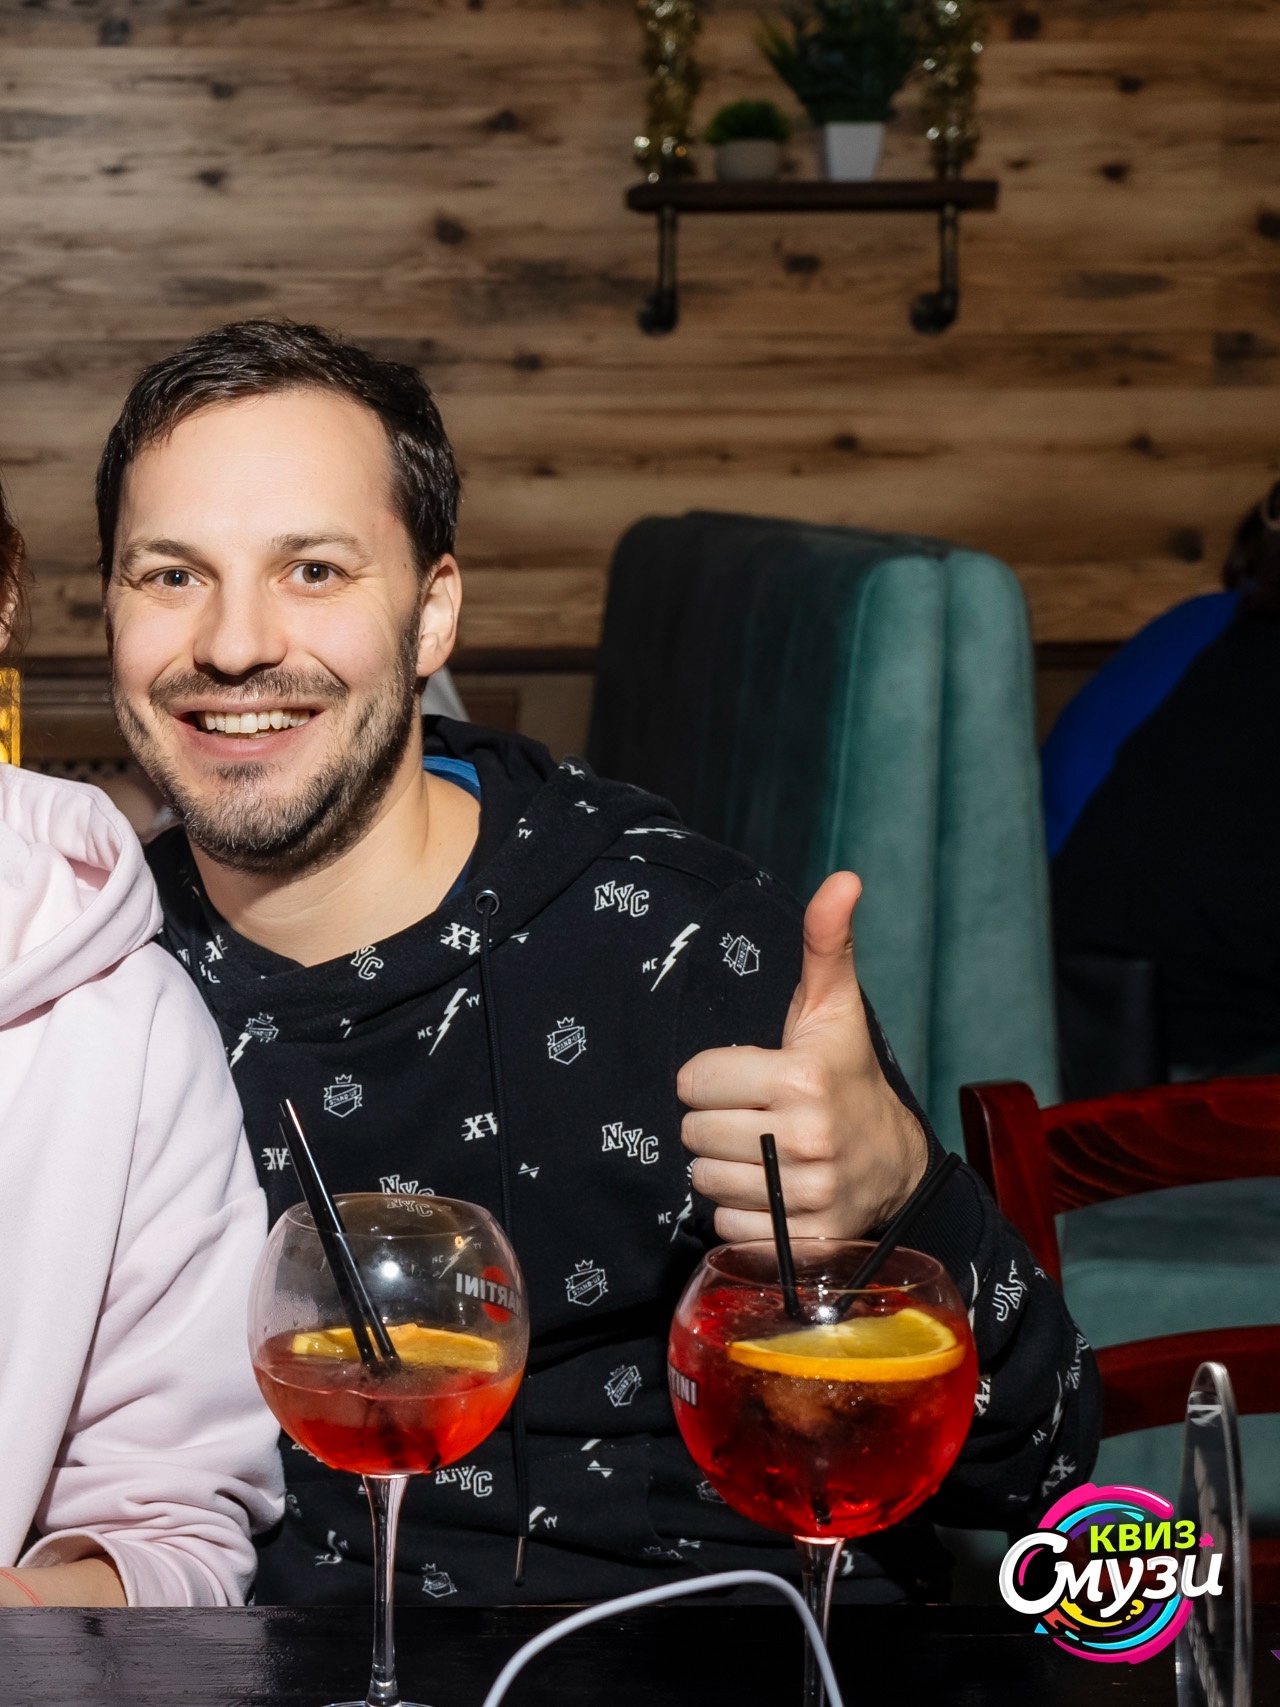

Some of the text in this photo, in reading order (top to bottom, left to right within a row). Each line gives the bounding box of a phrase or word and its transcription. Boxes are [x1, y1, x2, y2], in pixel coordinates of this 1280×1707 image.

[594, 880, 650, 918] NYC
[350, 945, 384, 980] YC
[601, 1121, 660, 1165] NYC
